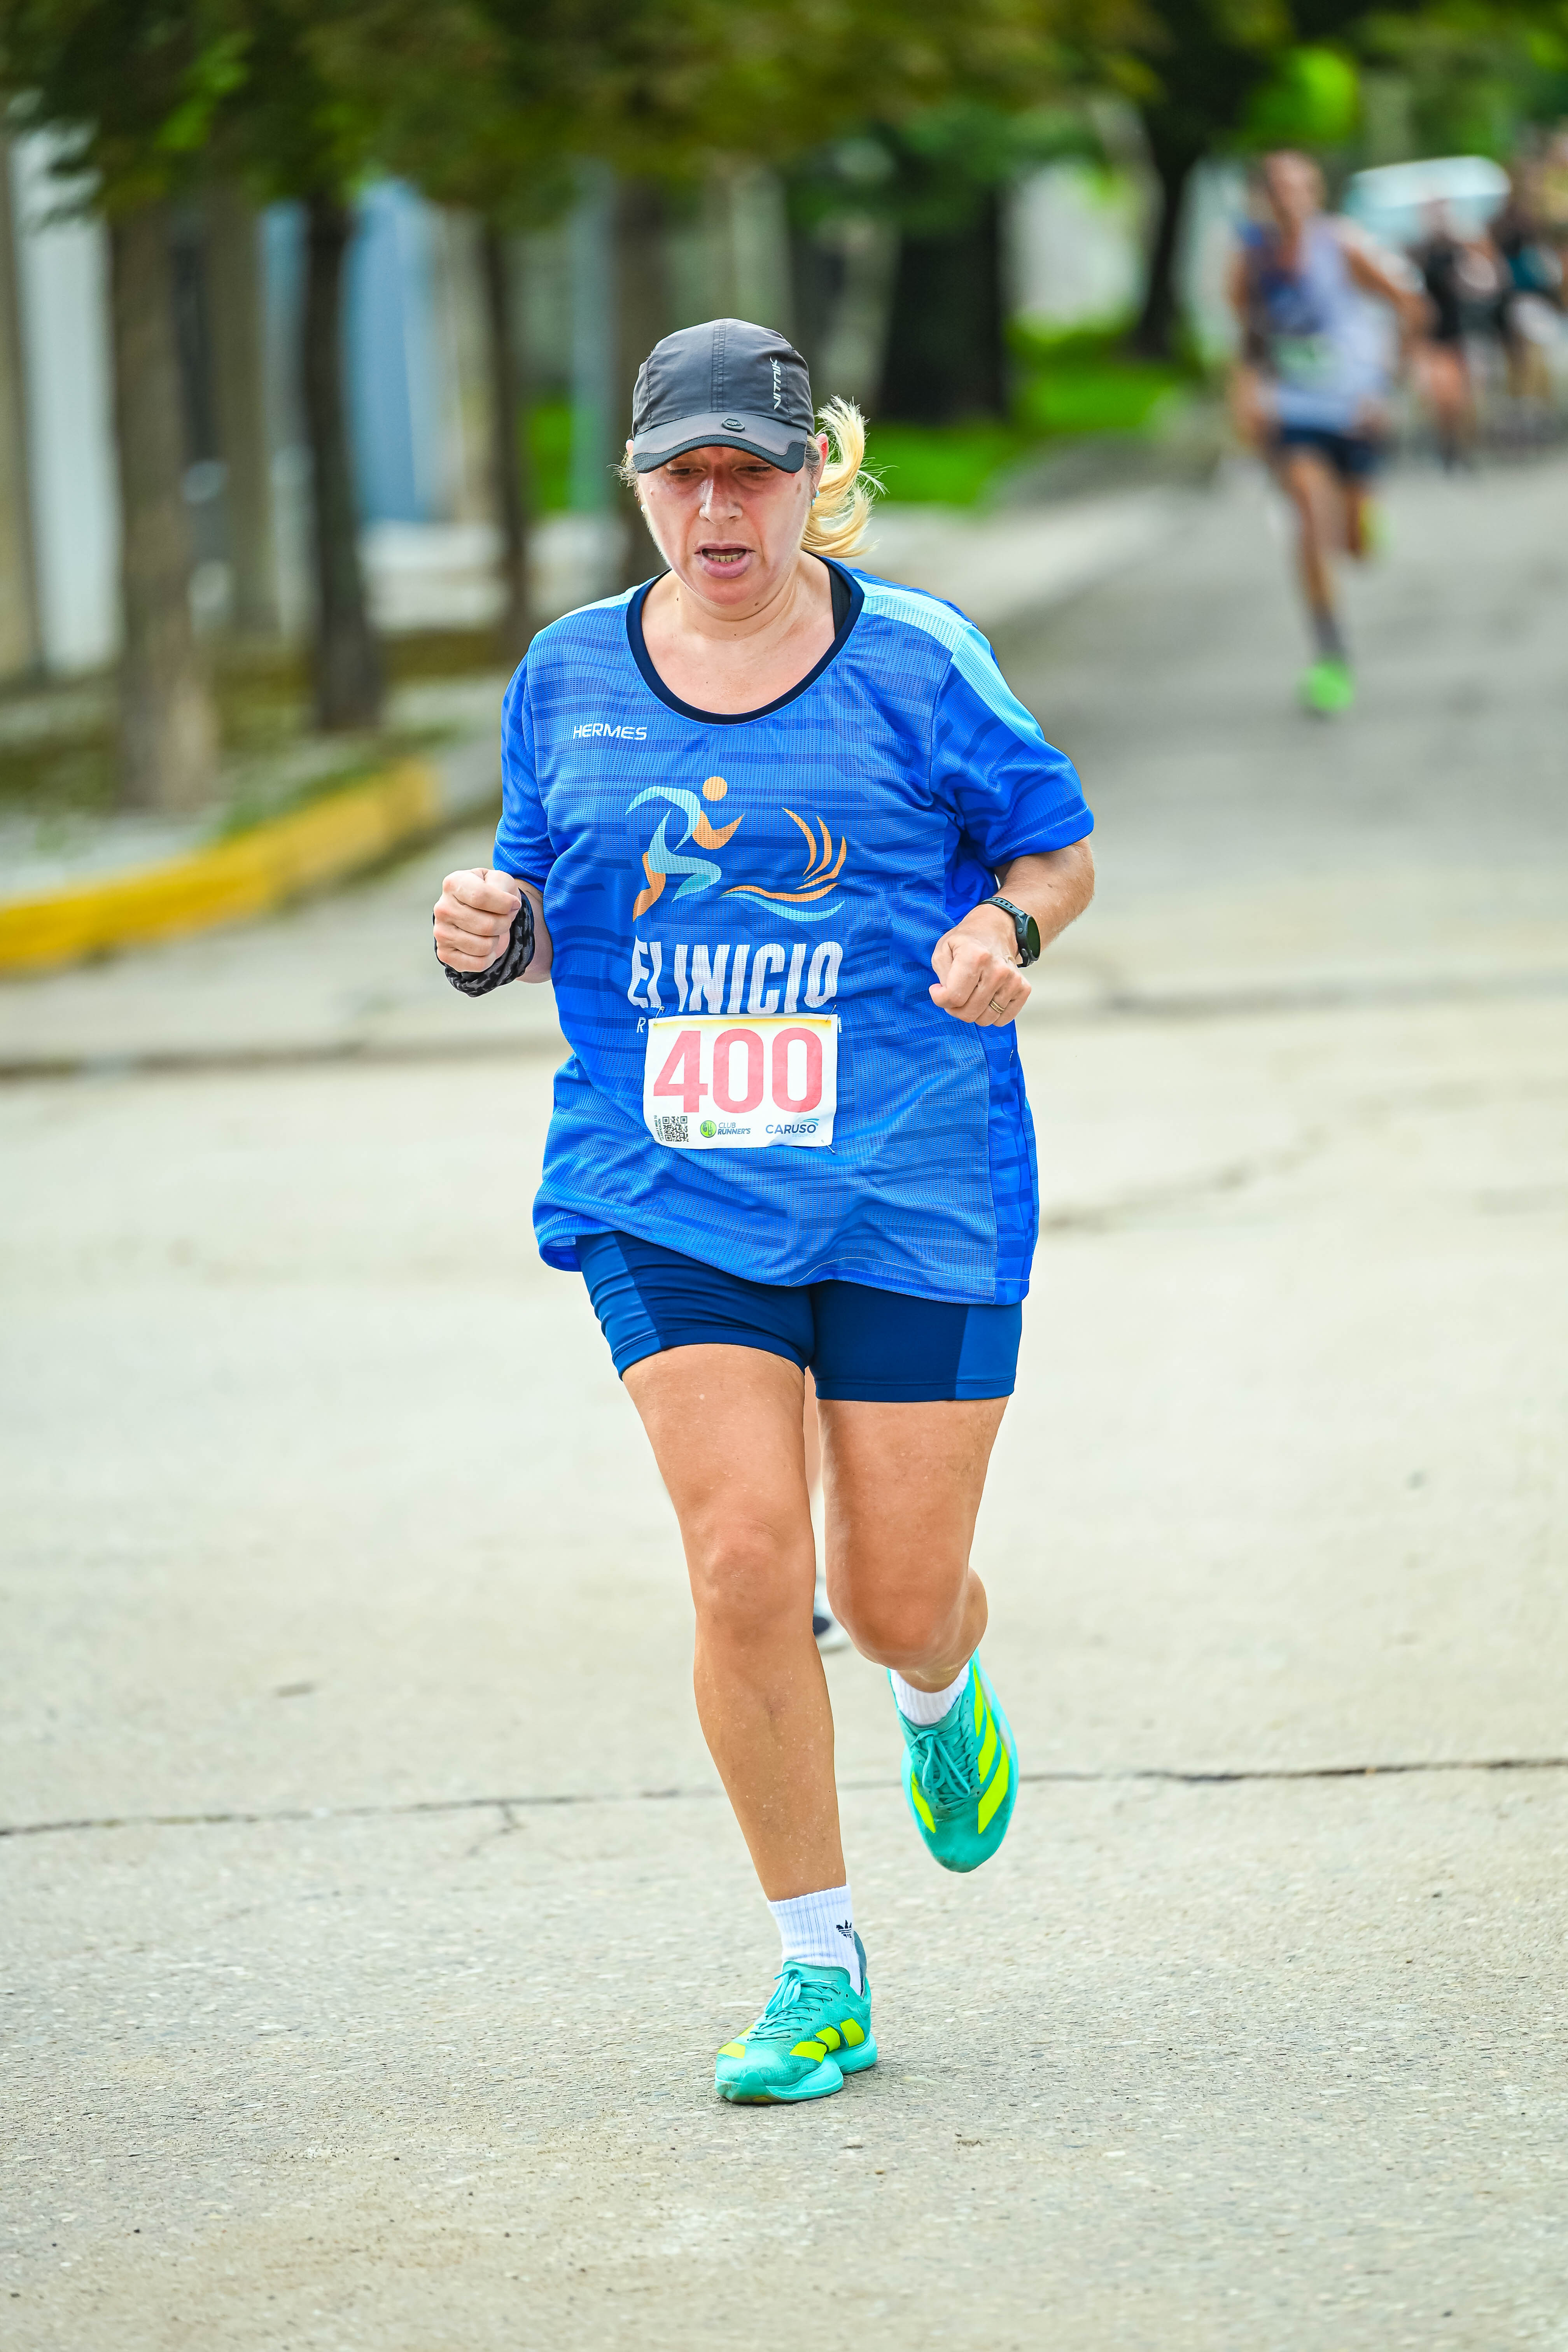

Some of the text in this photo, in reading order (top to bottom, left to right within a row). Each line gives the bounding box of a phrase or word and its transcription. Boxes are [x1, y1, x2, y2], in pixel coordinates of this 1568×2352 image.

[573, 723, 647, 740] HERMES
[674, 941, 844, 1014] INICIO
[653, 1027, 822, 1113] 400
[765, 1124, 816, 1134] CARUSO
